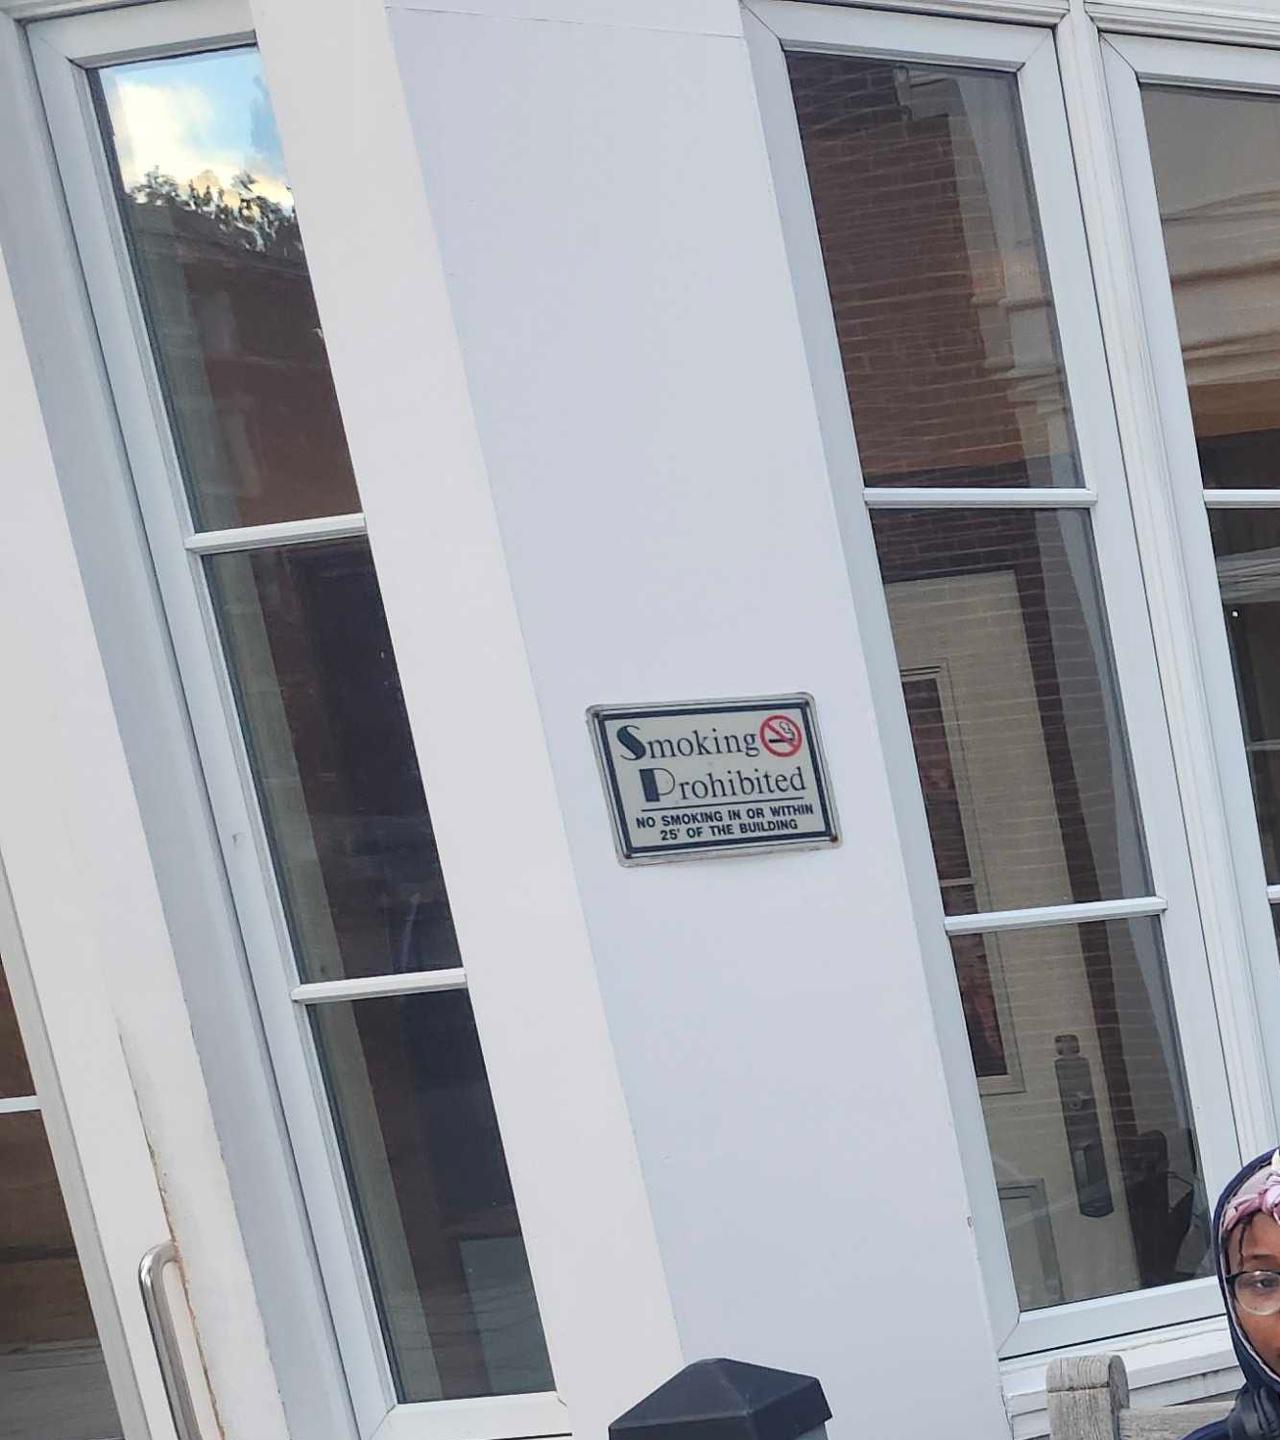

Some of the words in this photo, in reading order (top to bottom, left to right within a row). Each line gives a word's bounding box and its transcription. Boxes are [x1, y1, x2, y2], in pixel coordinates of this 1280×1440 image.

[616, 725, 760, 761] Smoking
[639, 767, 806, 802] Prohibited
[636, 816, 656, 828] NO
[662, 811, 723, 826] SMOKING
[729, 809, 742, 821] IN
[747, 807, 765, 819] OR
[769, 804, 814, 817] WITHIN
[660, 828, 681, 841] 25'
[686, 826, 703, 838] OF
[711, 823, 734, 836] THE
[740, 819, 798, 834] BUILDING
